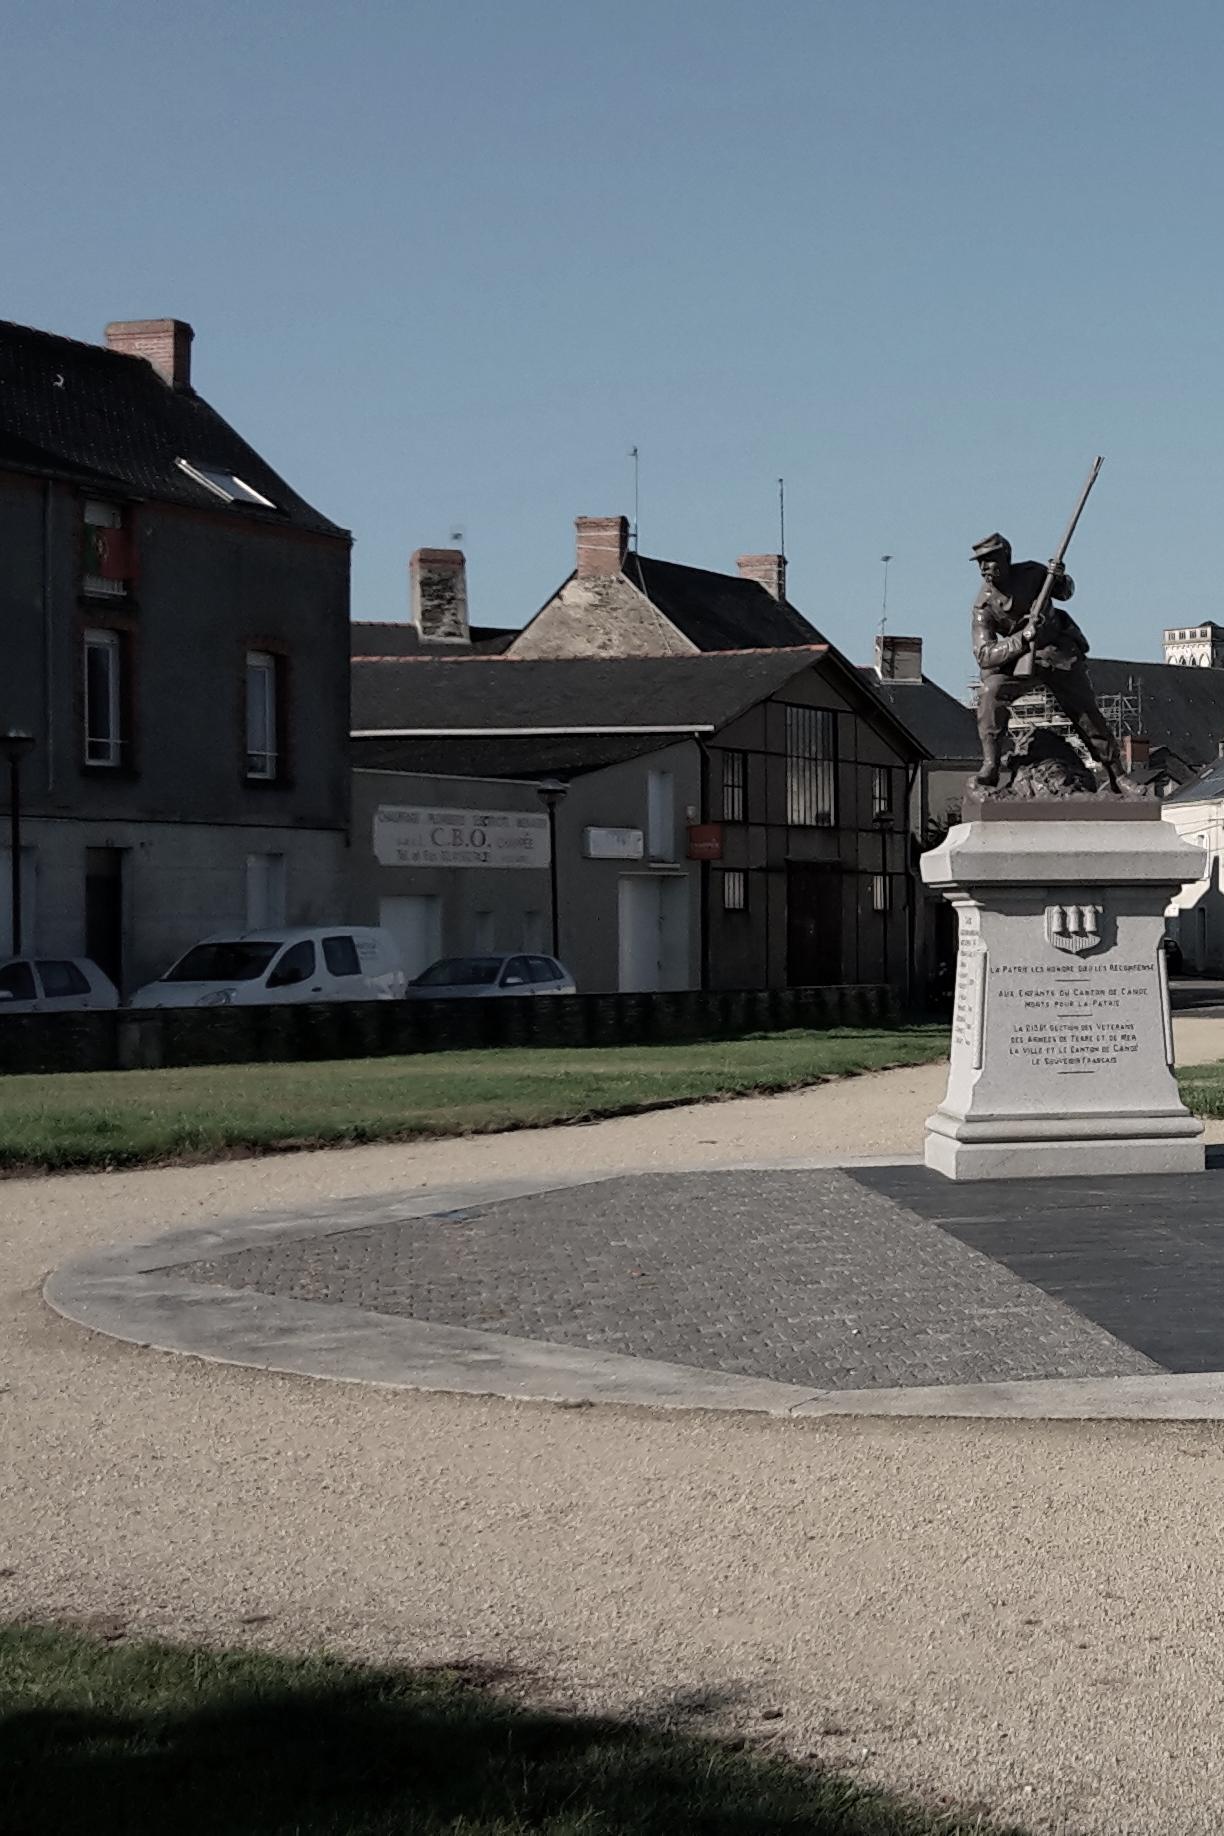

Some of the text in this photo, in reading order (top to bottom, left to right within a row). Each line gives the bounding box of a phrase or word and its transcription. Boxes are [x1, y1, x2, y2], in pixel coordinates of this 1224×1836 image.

[431, 827, 492, 848] C.B.O.
[990, 966, 1000, 974] LA
[1073, 988, 1106, 997] CANTON
[1054, 1000, 1074, 1008] POUR
[1092, 999, 1120, 1008] PATRIE
[1009, 1047, 1020, 1055] LA
[1022, 1047, 1043, 1055] VILLE
[1070, 1045, 1100, 1054] CANTON
